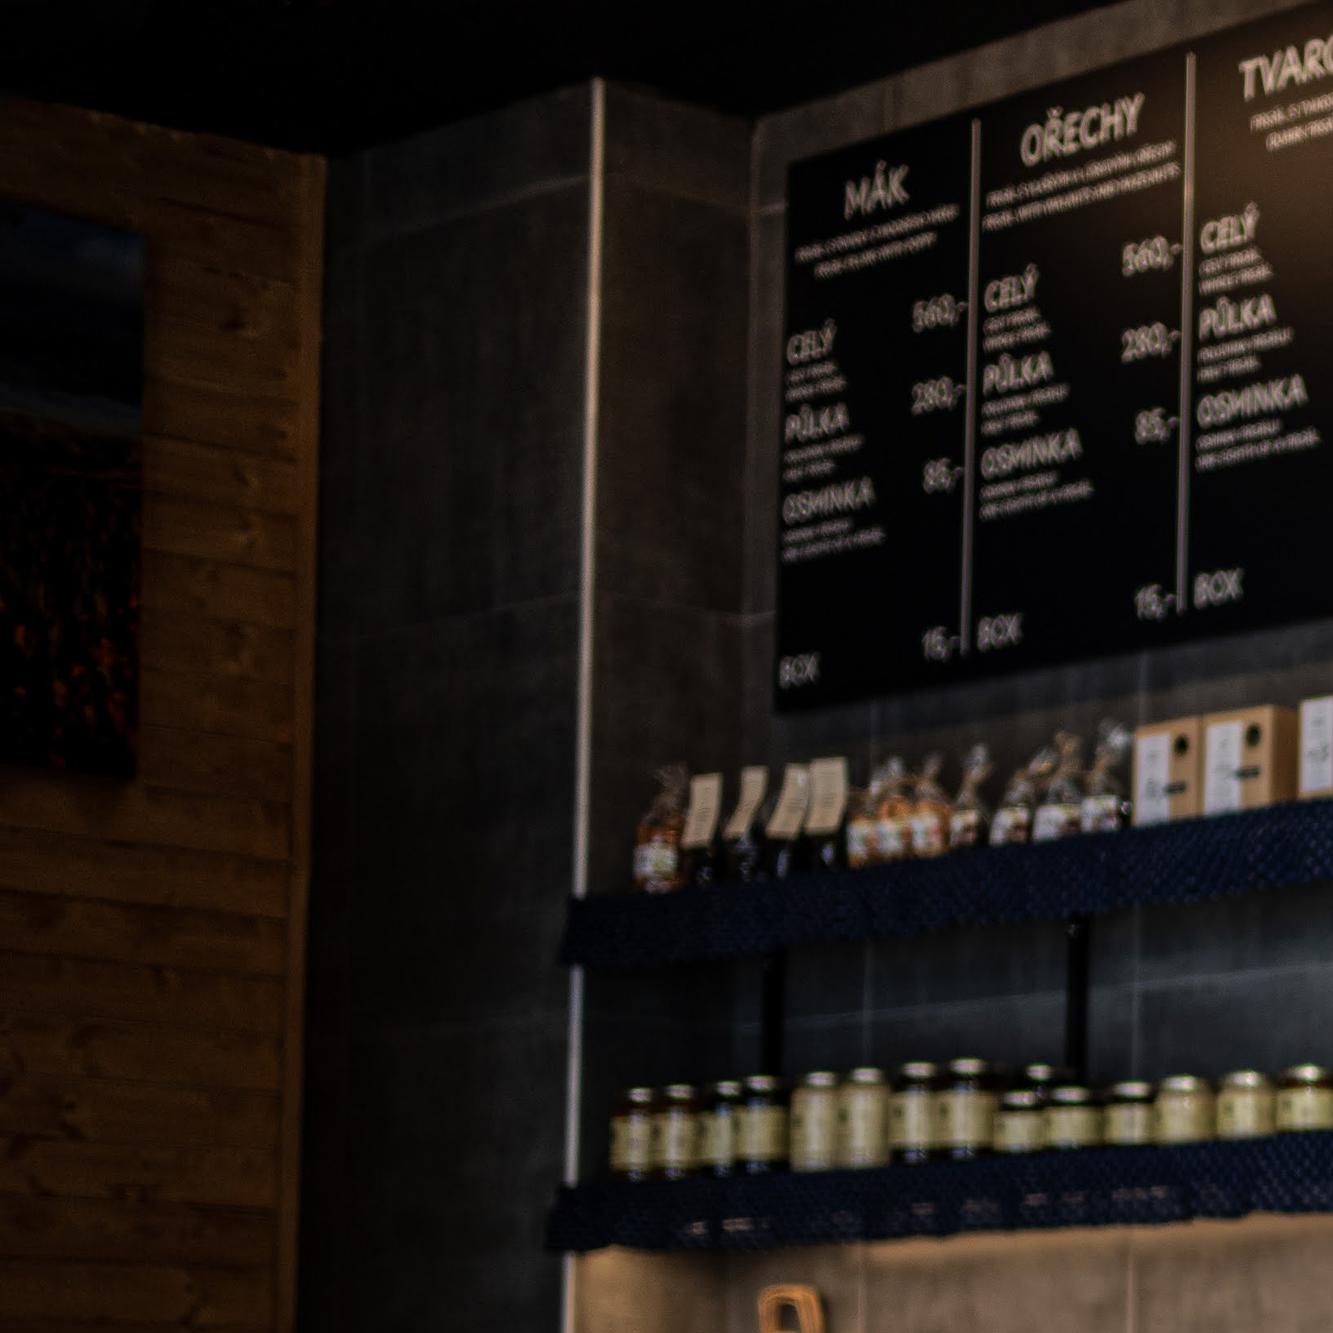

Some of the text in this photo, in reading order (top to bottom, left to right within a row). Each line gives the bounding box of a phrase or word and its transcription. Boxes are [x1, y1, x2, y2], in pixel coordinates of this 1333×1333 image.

[1020, 92, 1146, 167] OŘECHY
[844, 159, 909, 220] MÁK
[1200, 200, 1259, 254] CELÝ
[1197, 373, 1309, 429] OSMINKA
[1194, 568, 1244, 609] BOX
[977, 612, 1023, 652] BOX
[779, 652, 822, 689] BOX
